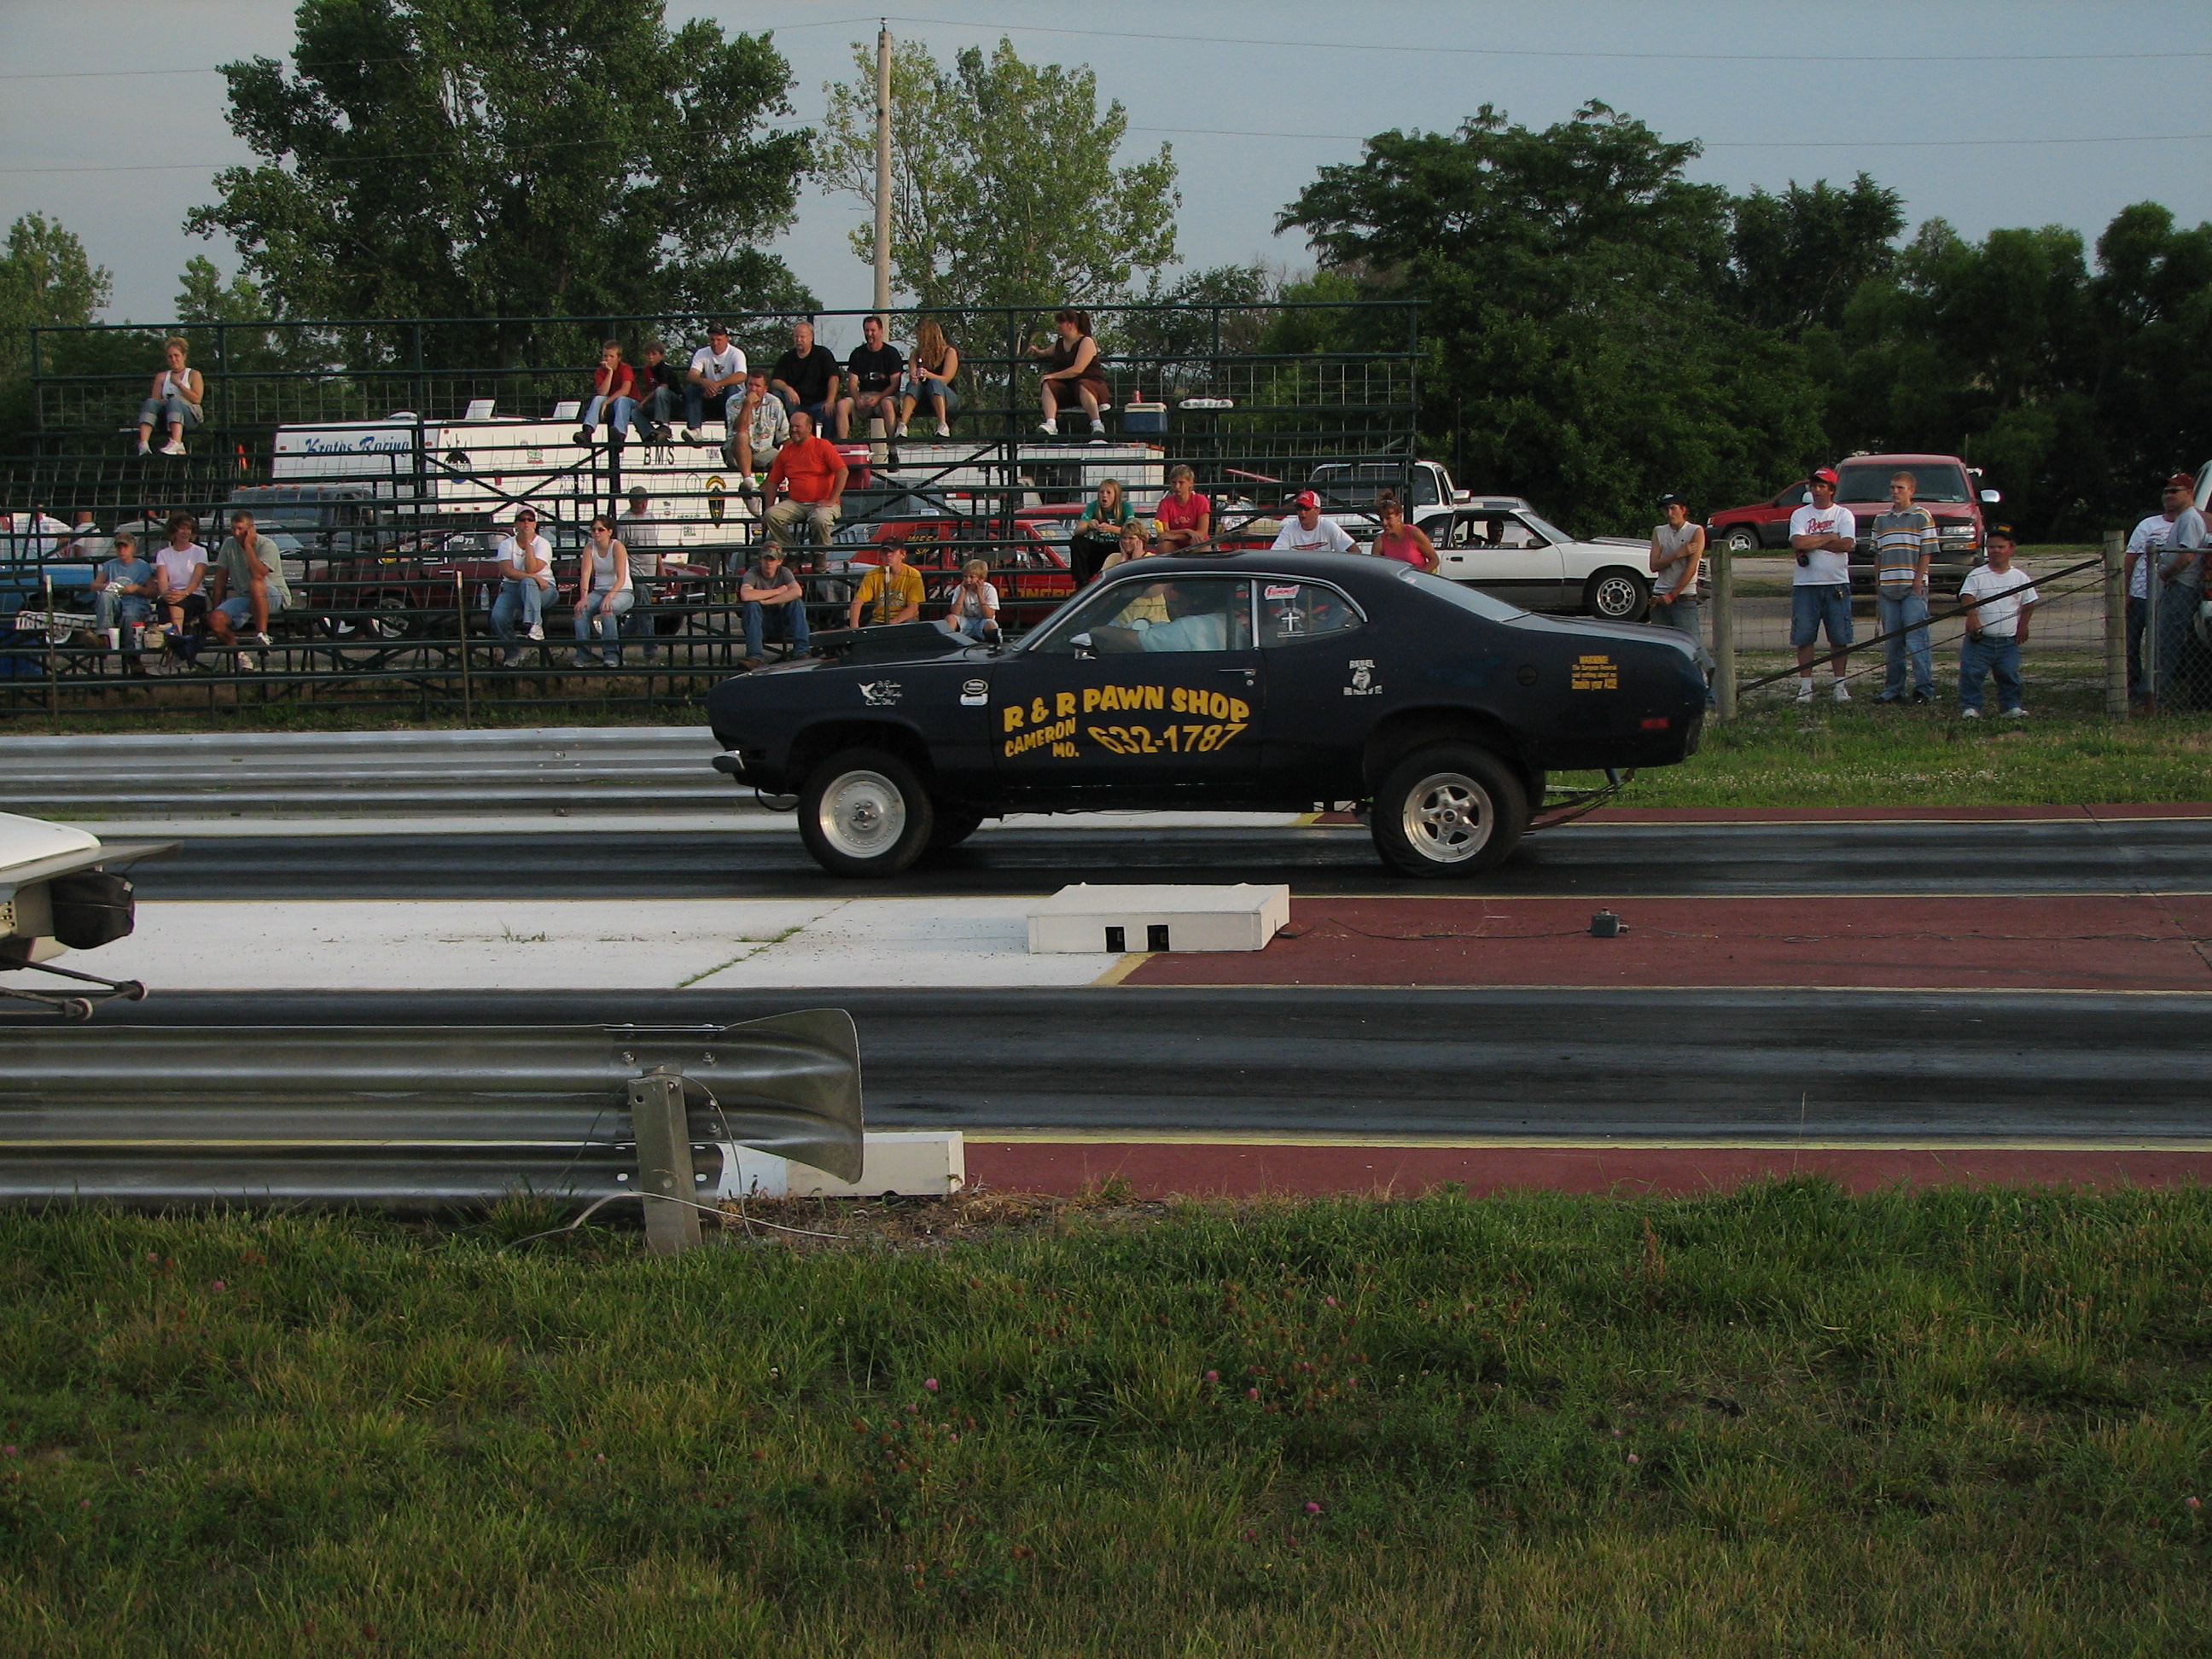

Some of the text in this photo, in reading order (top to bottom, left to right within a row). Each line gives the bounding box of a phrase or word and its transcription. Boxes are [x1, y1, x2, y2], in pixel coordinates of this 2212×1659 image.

[1003, 685, 1250, 732] R & R PAWN SHOP
[1004, 717, 1076, 758] CAMERON
[1051, 742, 1080, 758] MO.
[1087, 723, 1249, 754] 632-1787
